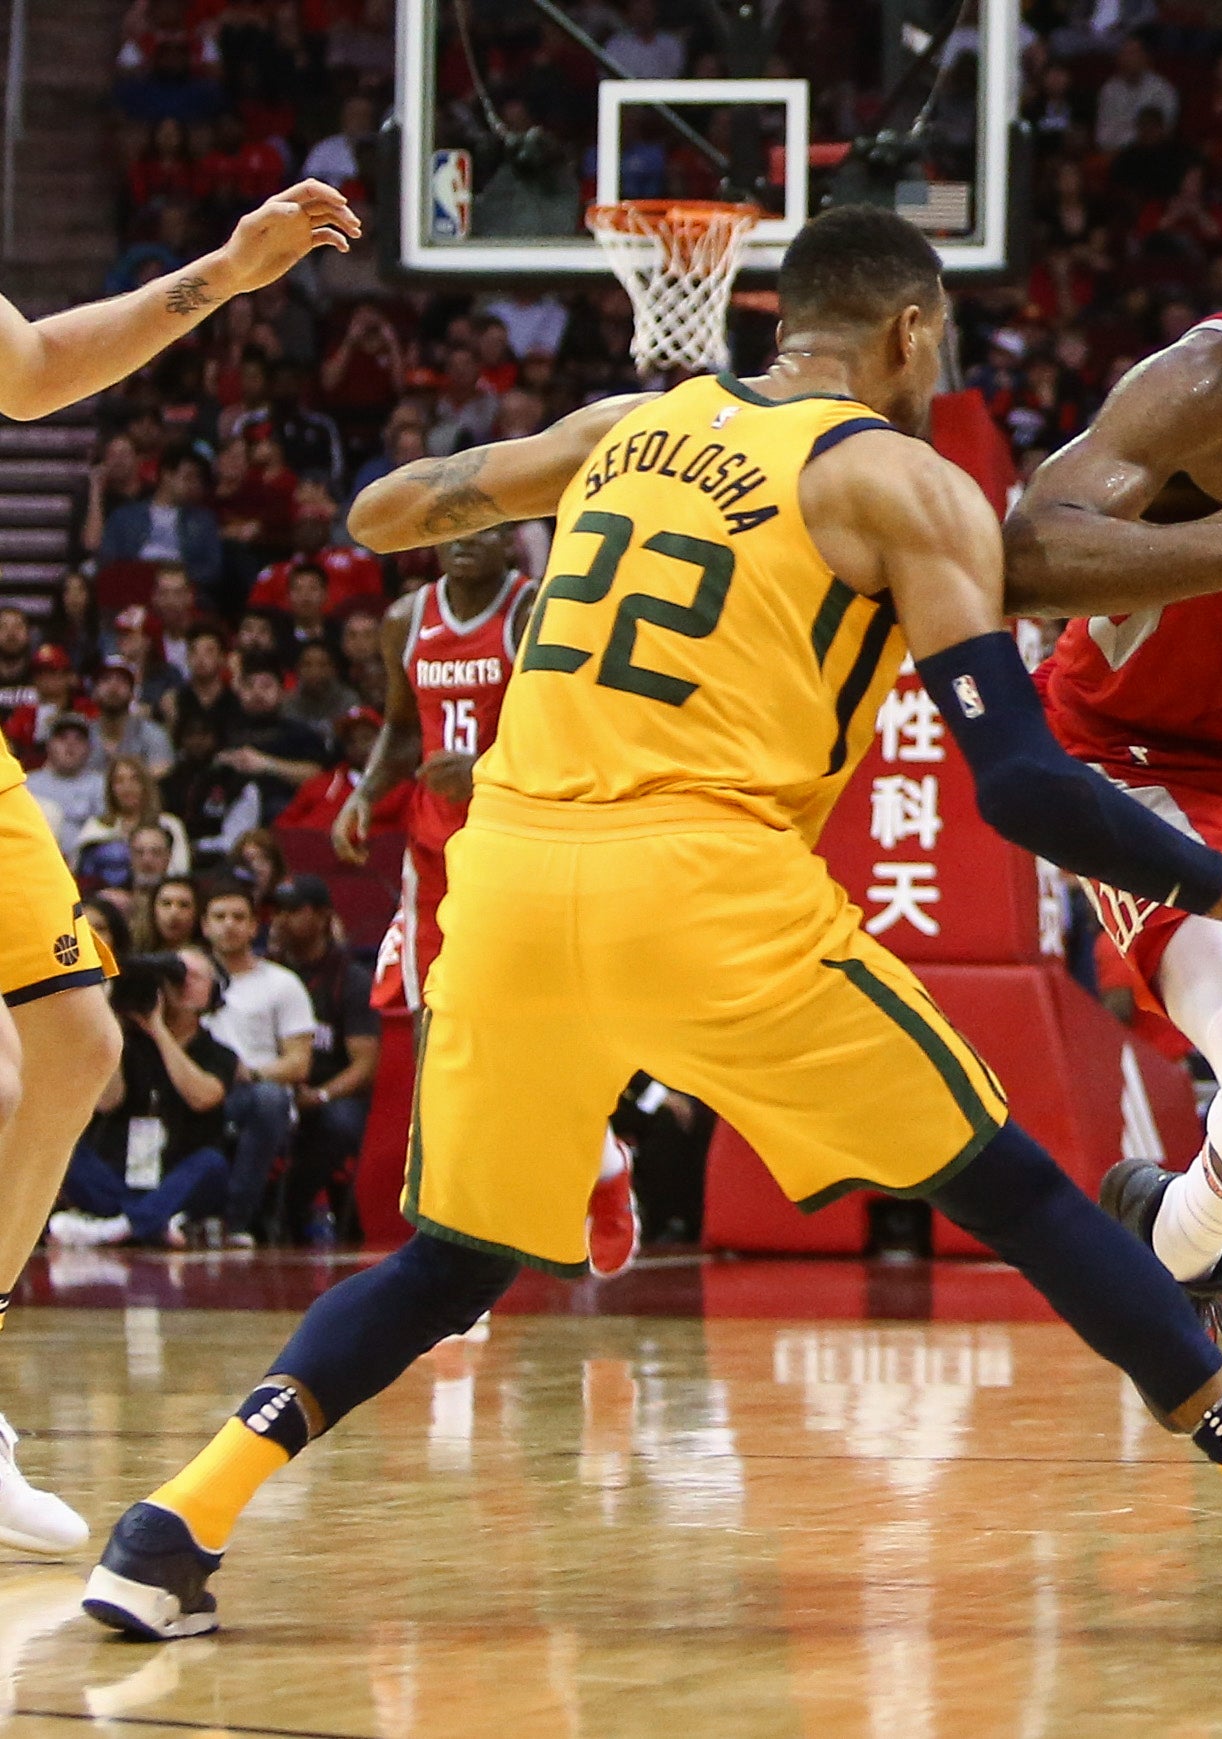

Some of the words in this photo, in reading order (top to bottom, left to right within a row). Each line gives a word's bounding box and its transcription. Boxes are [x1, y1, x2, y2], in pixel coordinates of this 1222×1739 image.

[585, 429, 779, 535] SEFOLOSHA
[520, 511, 735, 707] 22
[416, 657, 501, 688] ROCKETS
[441, 698, 478, 755] 15
[865, 648, 946, 936] 性科天
